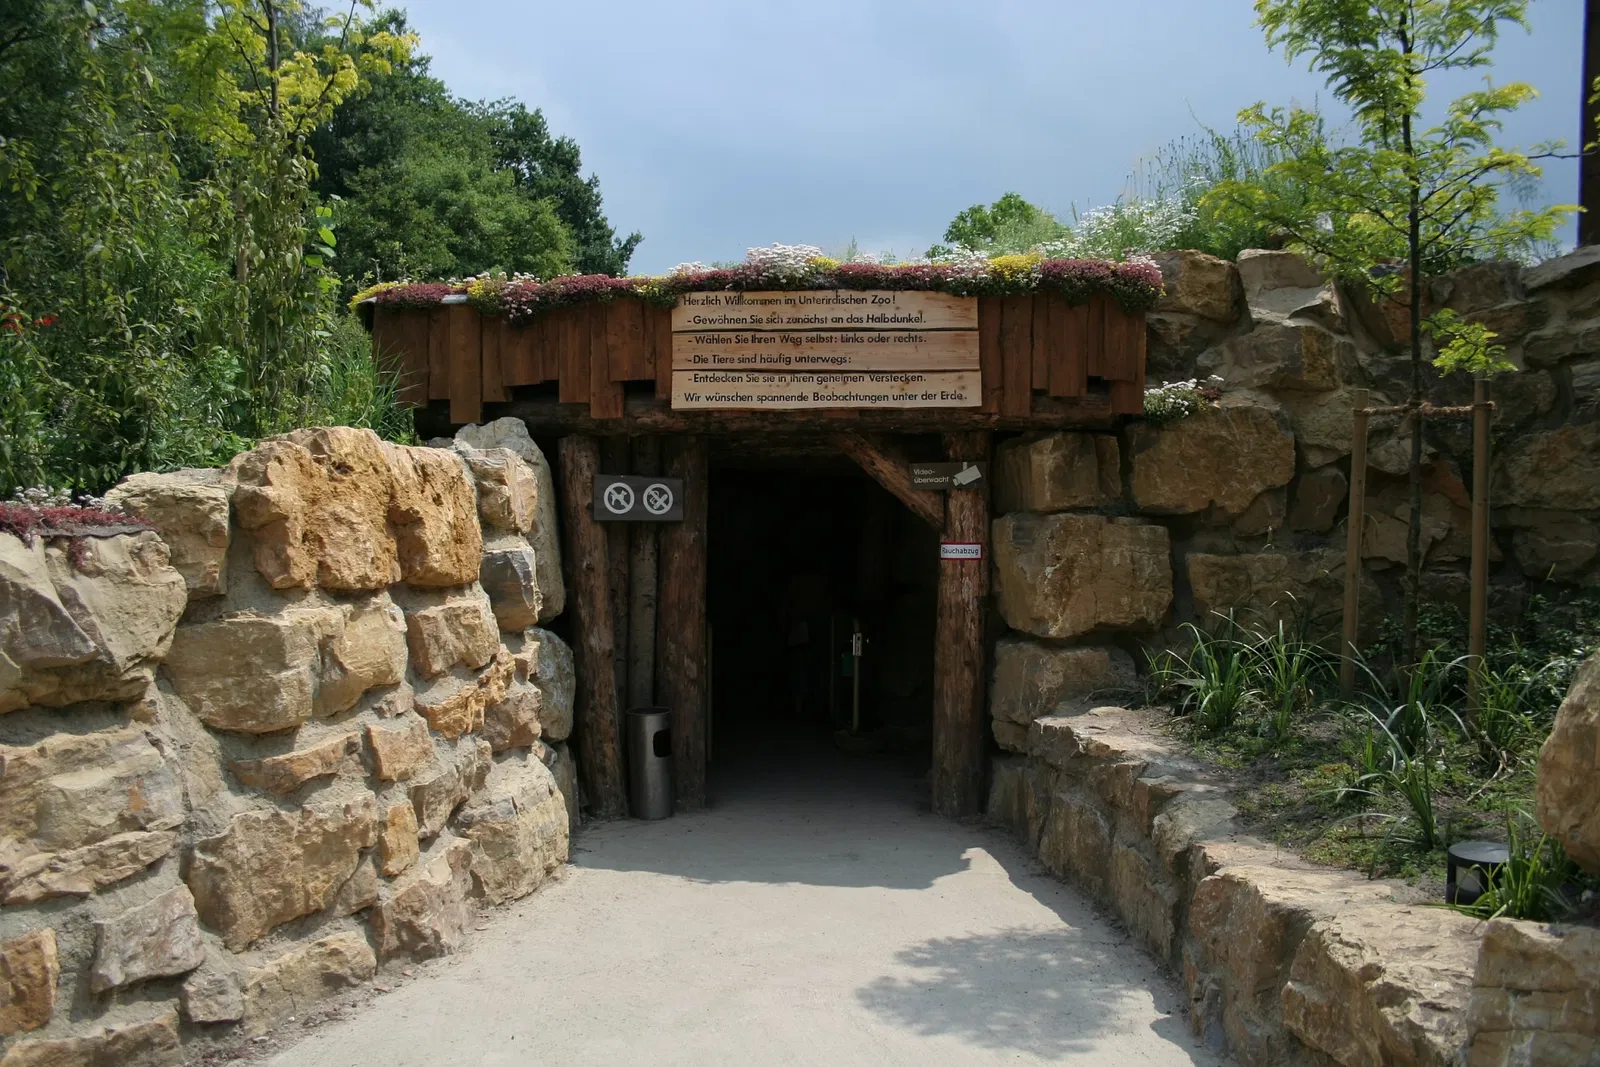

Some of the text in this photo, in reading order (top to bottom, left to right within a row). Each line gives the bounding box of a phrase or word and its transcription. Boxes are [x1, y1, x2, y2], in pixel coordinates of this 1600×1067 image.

[684, 295, 895, 305] Herzlich Willkommen im Unterirdischen Zoo!
[750, 315, 763, 324] Sie
[766, 315, 783, 324] sich
[786, 315, 827, 324] zunächst
[831, 316, 843, 324] an
[847, 314, 863, 324] das
[866, 313, 925, 323] Halbdunkel.
[735, 335, 748, 344] Sie
[752, 335, 775, 343] Ihren
[779, 335, 802, 345] Weg
[805, 334, 837, 343] selbst:
[841, 334, 864, 343] Links
[868, 334, 890, 343] oder
[894, 334, 926, 342] rechts.
[712, 355, 734, 363] Tiere
[738, 355, 756, 363] sind
[760, 354, 791, 365] häufig
[795, 355, 851, 365] unterwegs:
[746, 374, 759, 382] Sie
[763, 374, 775, 382] sie
[778, 374, 786, 382] in
[817, 375, 864, 385] geheimen
[869, 374, 926, 382] Verstecken.
[684, 391, 967, 403] Wir wünschen spannende Beobachtungen unter der Erde.
[942, 547, 978, 555] Rauchabzug
